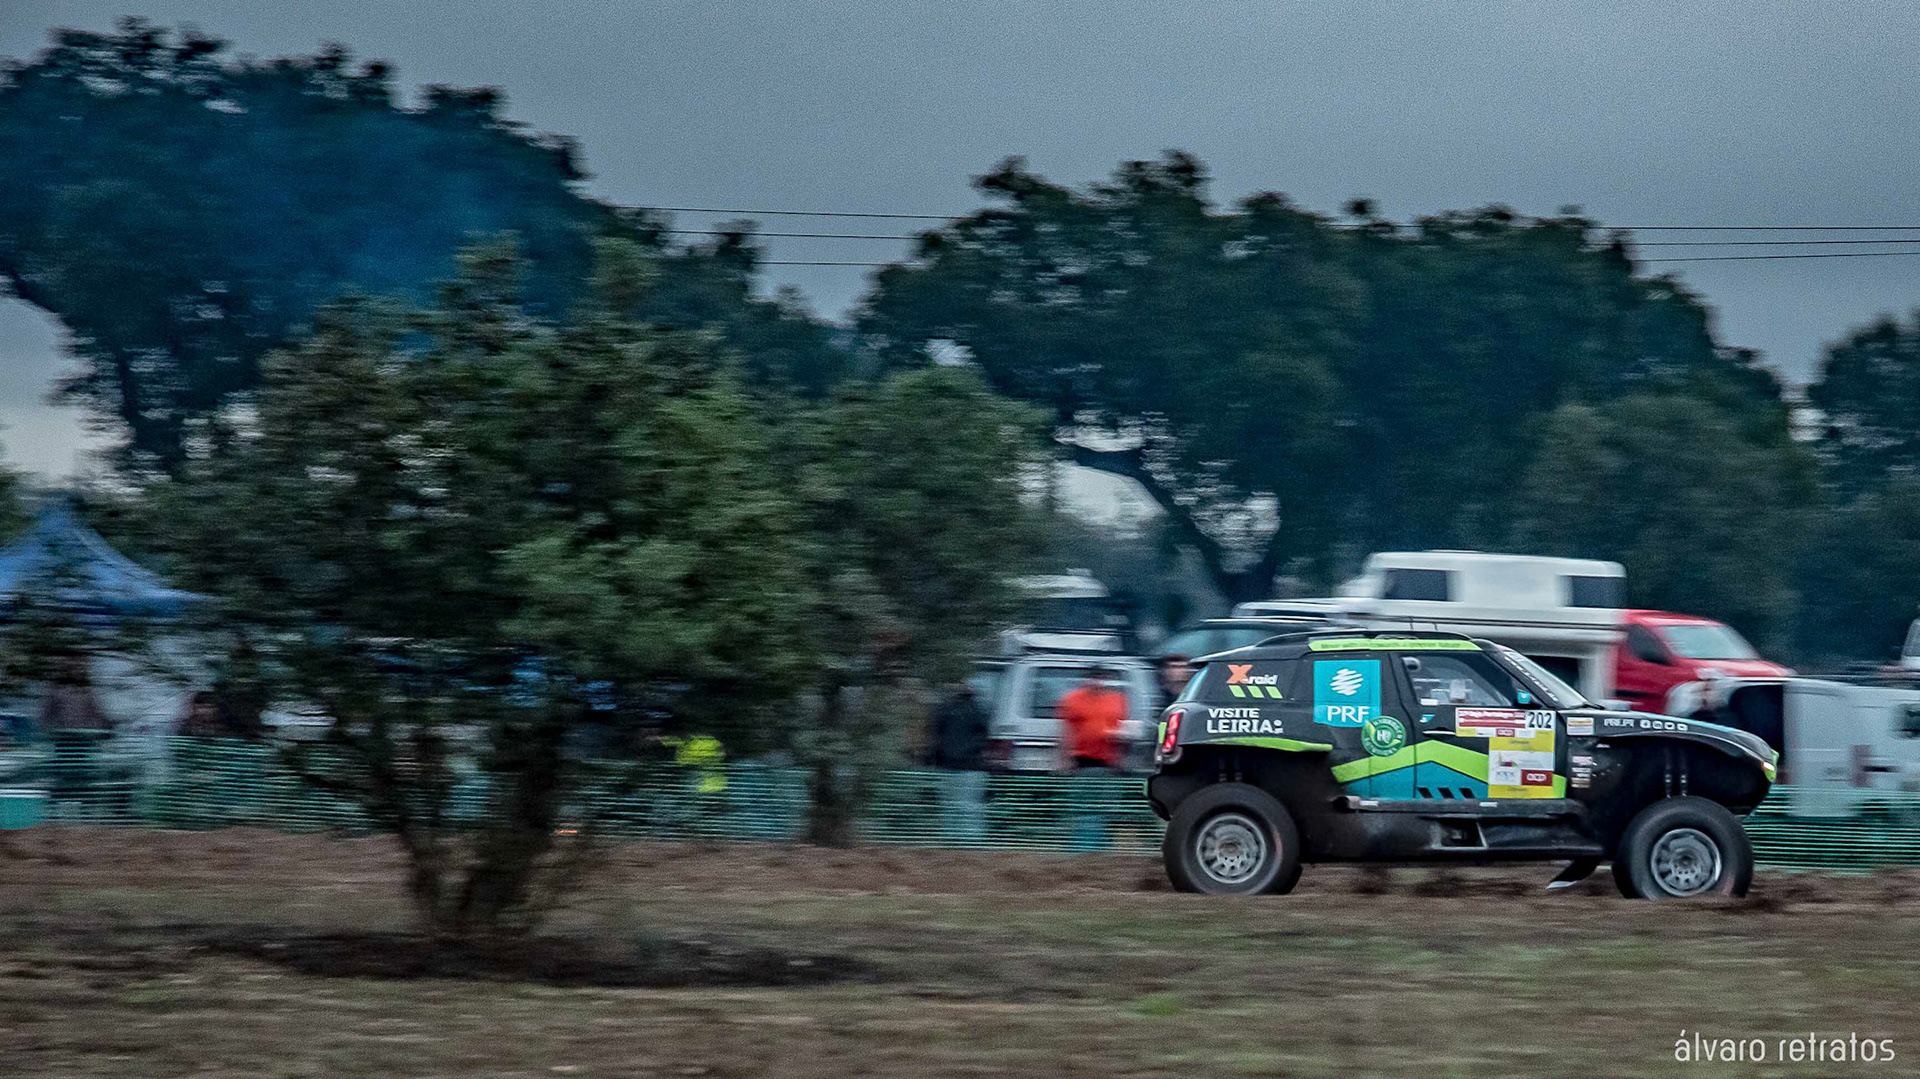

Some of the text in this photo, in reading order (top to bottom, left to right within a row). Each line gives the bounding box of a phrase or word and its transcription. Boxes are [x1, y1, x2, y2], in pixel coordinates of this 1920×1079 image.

[1208, 708, 1259, 718] VISITE
[1327, 705, 1370, 723] PRF
[1528, 711, 1552, 728] 202
